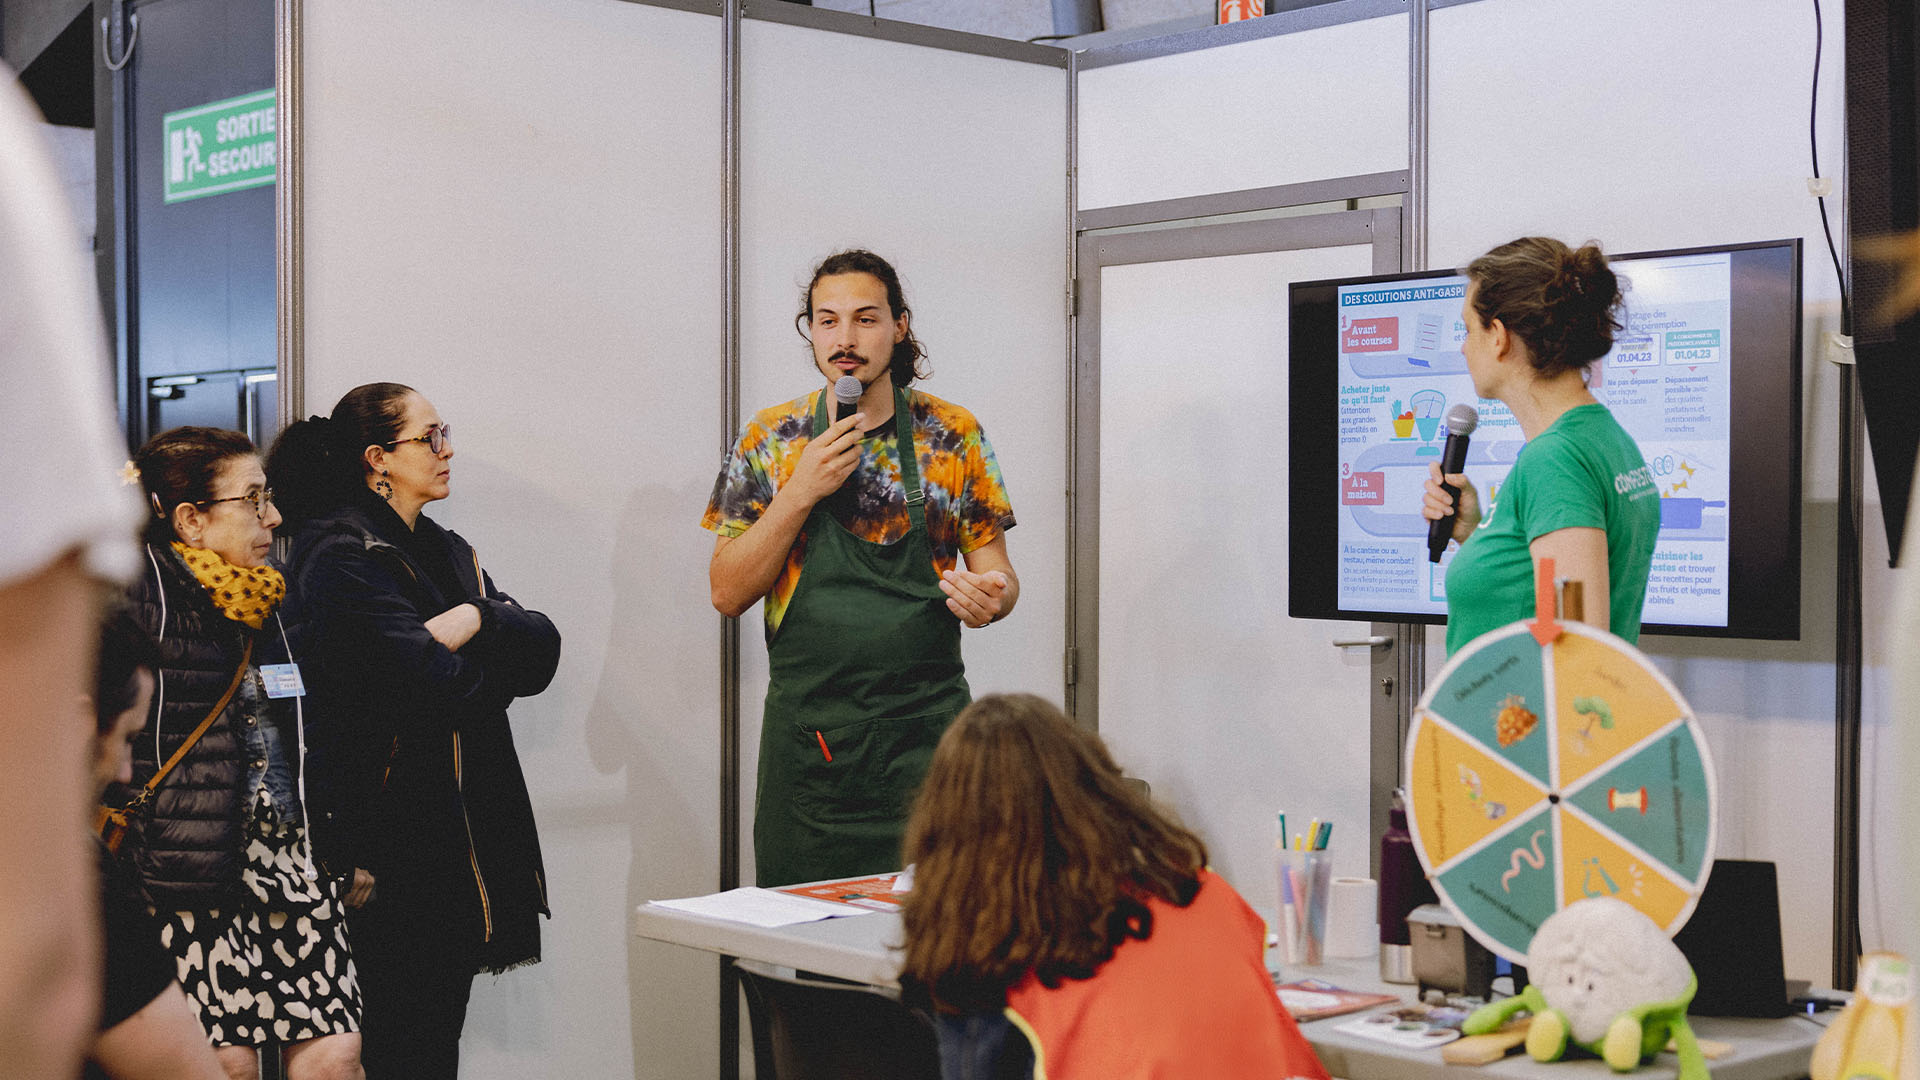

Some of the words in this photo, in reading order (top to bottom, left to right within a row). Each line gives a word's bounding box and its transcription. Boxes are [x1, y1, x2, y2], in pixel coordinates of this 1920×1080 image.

[216, 106, 276, 144] SORTIE
[1345, 295, 1361, 305] DES
[1362, 291, 1412, 303] SOLUTIONS
[1413, 286, 1464, 299] ANTI-GASPI
[1341, 315, 1347, 328] 1
[1352, 325, 1377, 335] Avant
[1347, 337, 1359, 347] les
[1361, 336, 1393, 346] courses
[1617, 352, 1652, 363] 01.04.23
[1675, 349, 1711, 360] 01.04.23
[1341, 386, 1369, 395] Acheter
[1371, 384, 1390, 395] juste
[1342, 463, 1349, 476] 3
[1360, 477, 1368, 488] la
[1347, 490, 1377, 499] maison
[1690, 552, 1703, 560] les
[1663, 575, 1693, 583] recettes
[1695, 577, 1712, 585] pour
[1660, 585, 1679, 594] fruits
[1690, 585, 1721, 597] légumes
